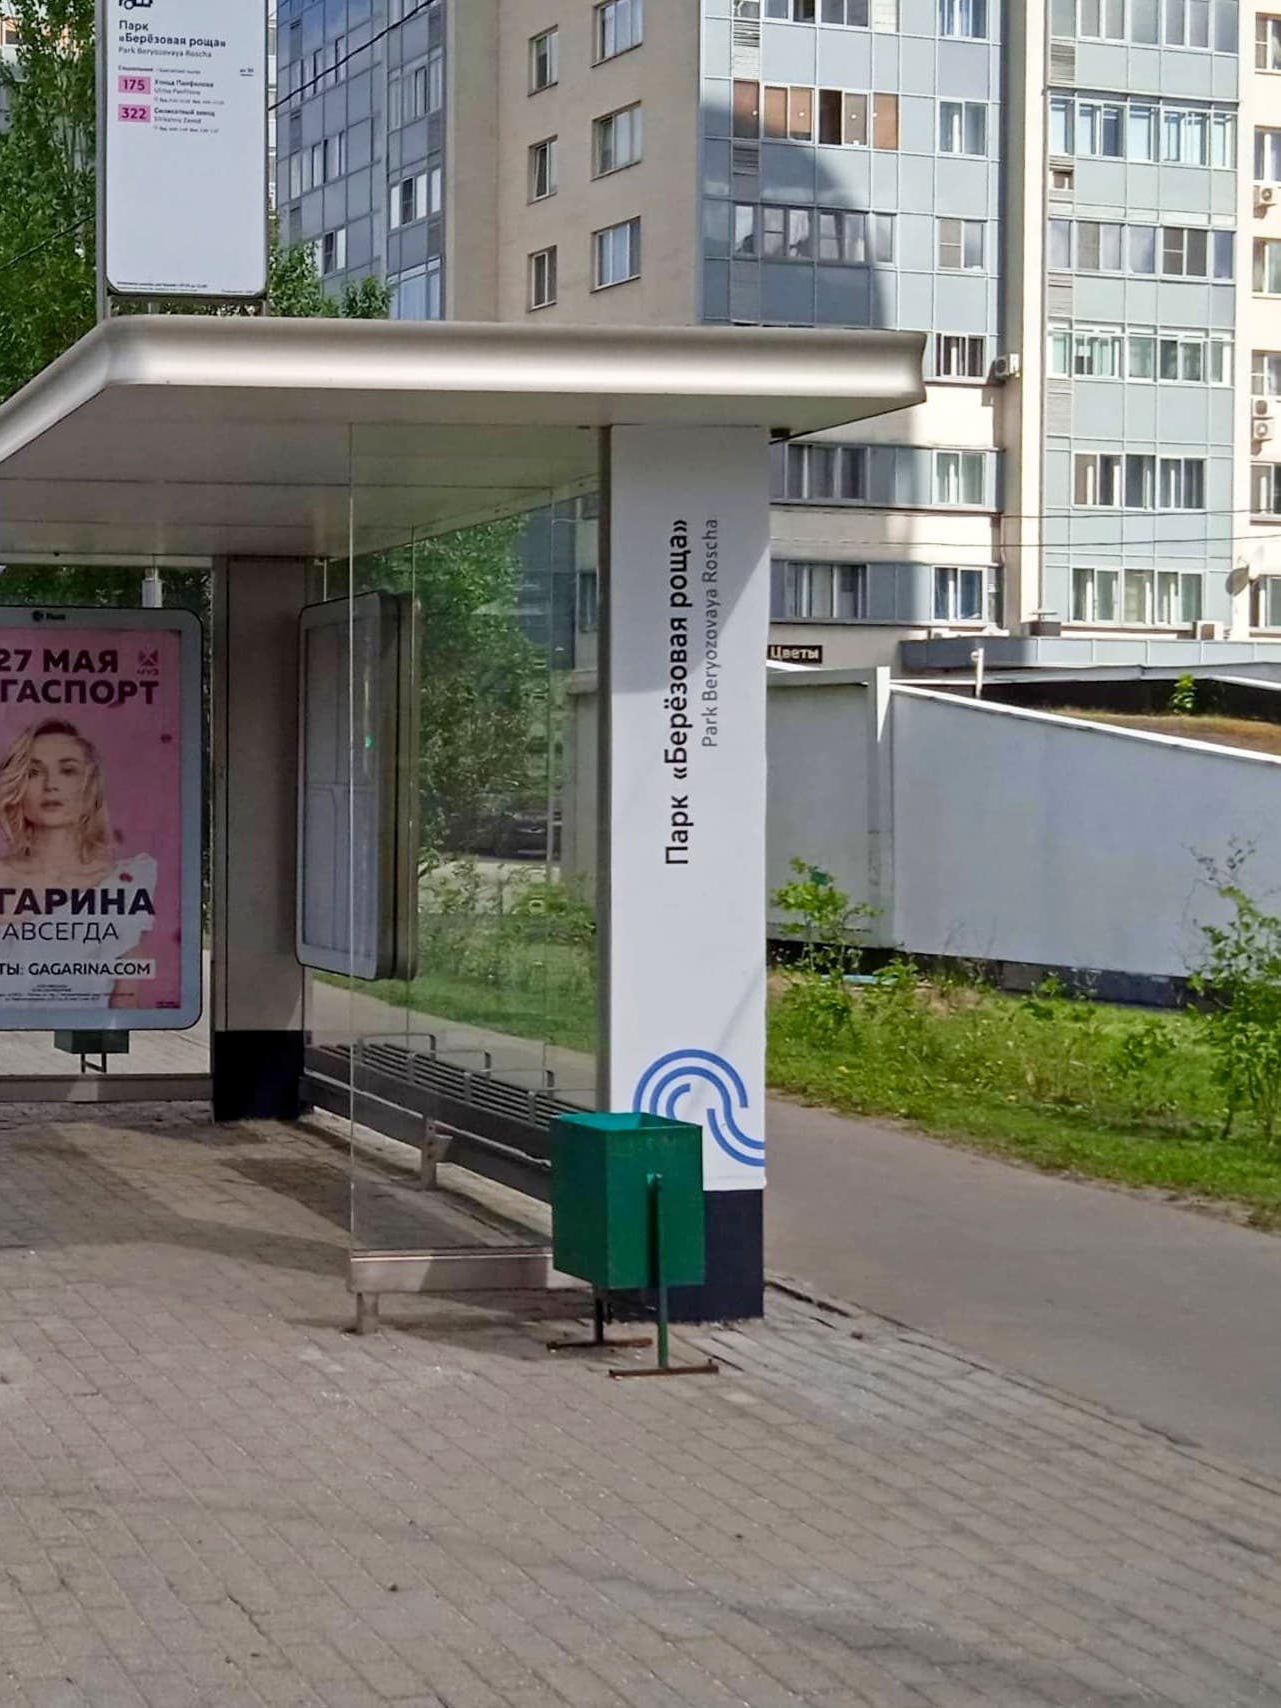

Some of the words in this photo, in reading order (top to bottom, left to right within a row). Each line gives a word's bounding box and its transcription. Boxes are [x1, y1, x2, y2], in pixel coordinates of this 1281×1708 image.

[119, 20, 149, 32] Парк
[123, 79, 145, 91] 175
[122, 107, 147, 120] 322
[669, 519, 693, 611] роща»
[701, 519, 719, 583] Roscha
[43, 649, 119, 673] МАЯ
[701, 590, 720, 703] Beryozovaya
[770, 646, 819, 660] Цветы
[664, 617, 694, 780] «Берёзовая
[701, 706, 718, 747] Park
[665, 795, 695, 865] Парк
[28, 962, 151, 976] GAGARINA.COM
